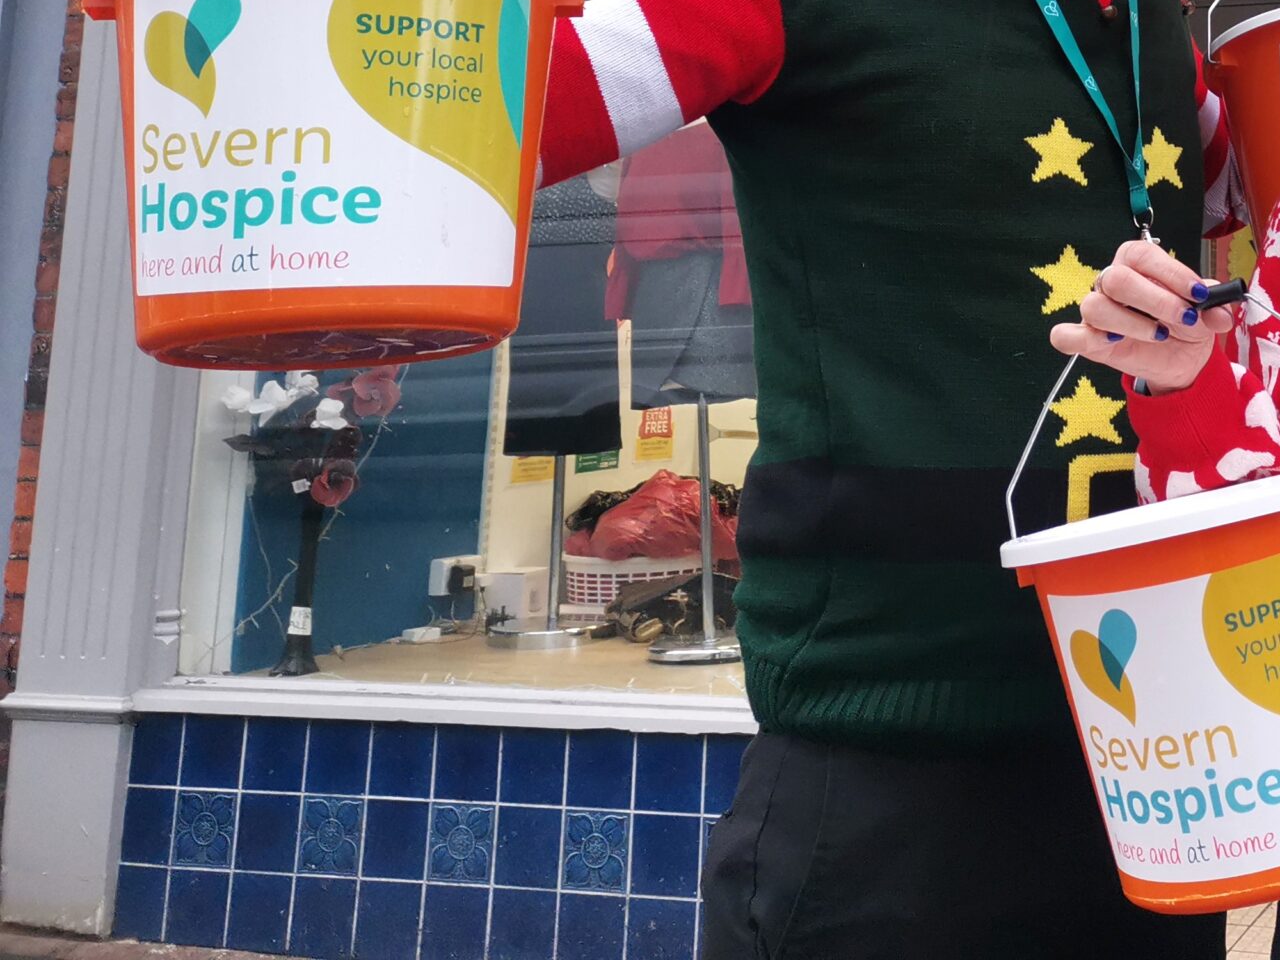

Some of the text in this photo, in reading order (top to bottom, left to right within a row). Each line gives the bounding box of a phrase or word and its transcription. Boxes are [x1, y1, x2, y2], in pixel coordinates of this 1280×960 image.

[356, 13, 485, 43] SUPPORT
[362, 47, 484, 74] your local
[389, 75, 483, 104] hospice
[141, 122, 332, 174] Severn
[141, 170, 382, 239] Hospice
[141, 244, 350, 278] here and at home
[644, 420, 669, 434] FREE
[645, 411, 668, 421] EXTRA
[1088, 723, 1240, 772] Severn
[1115, 831, 1277, 865] here and at home
